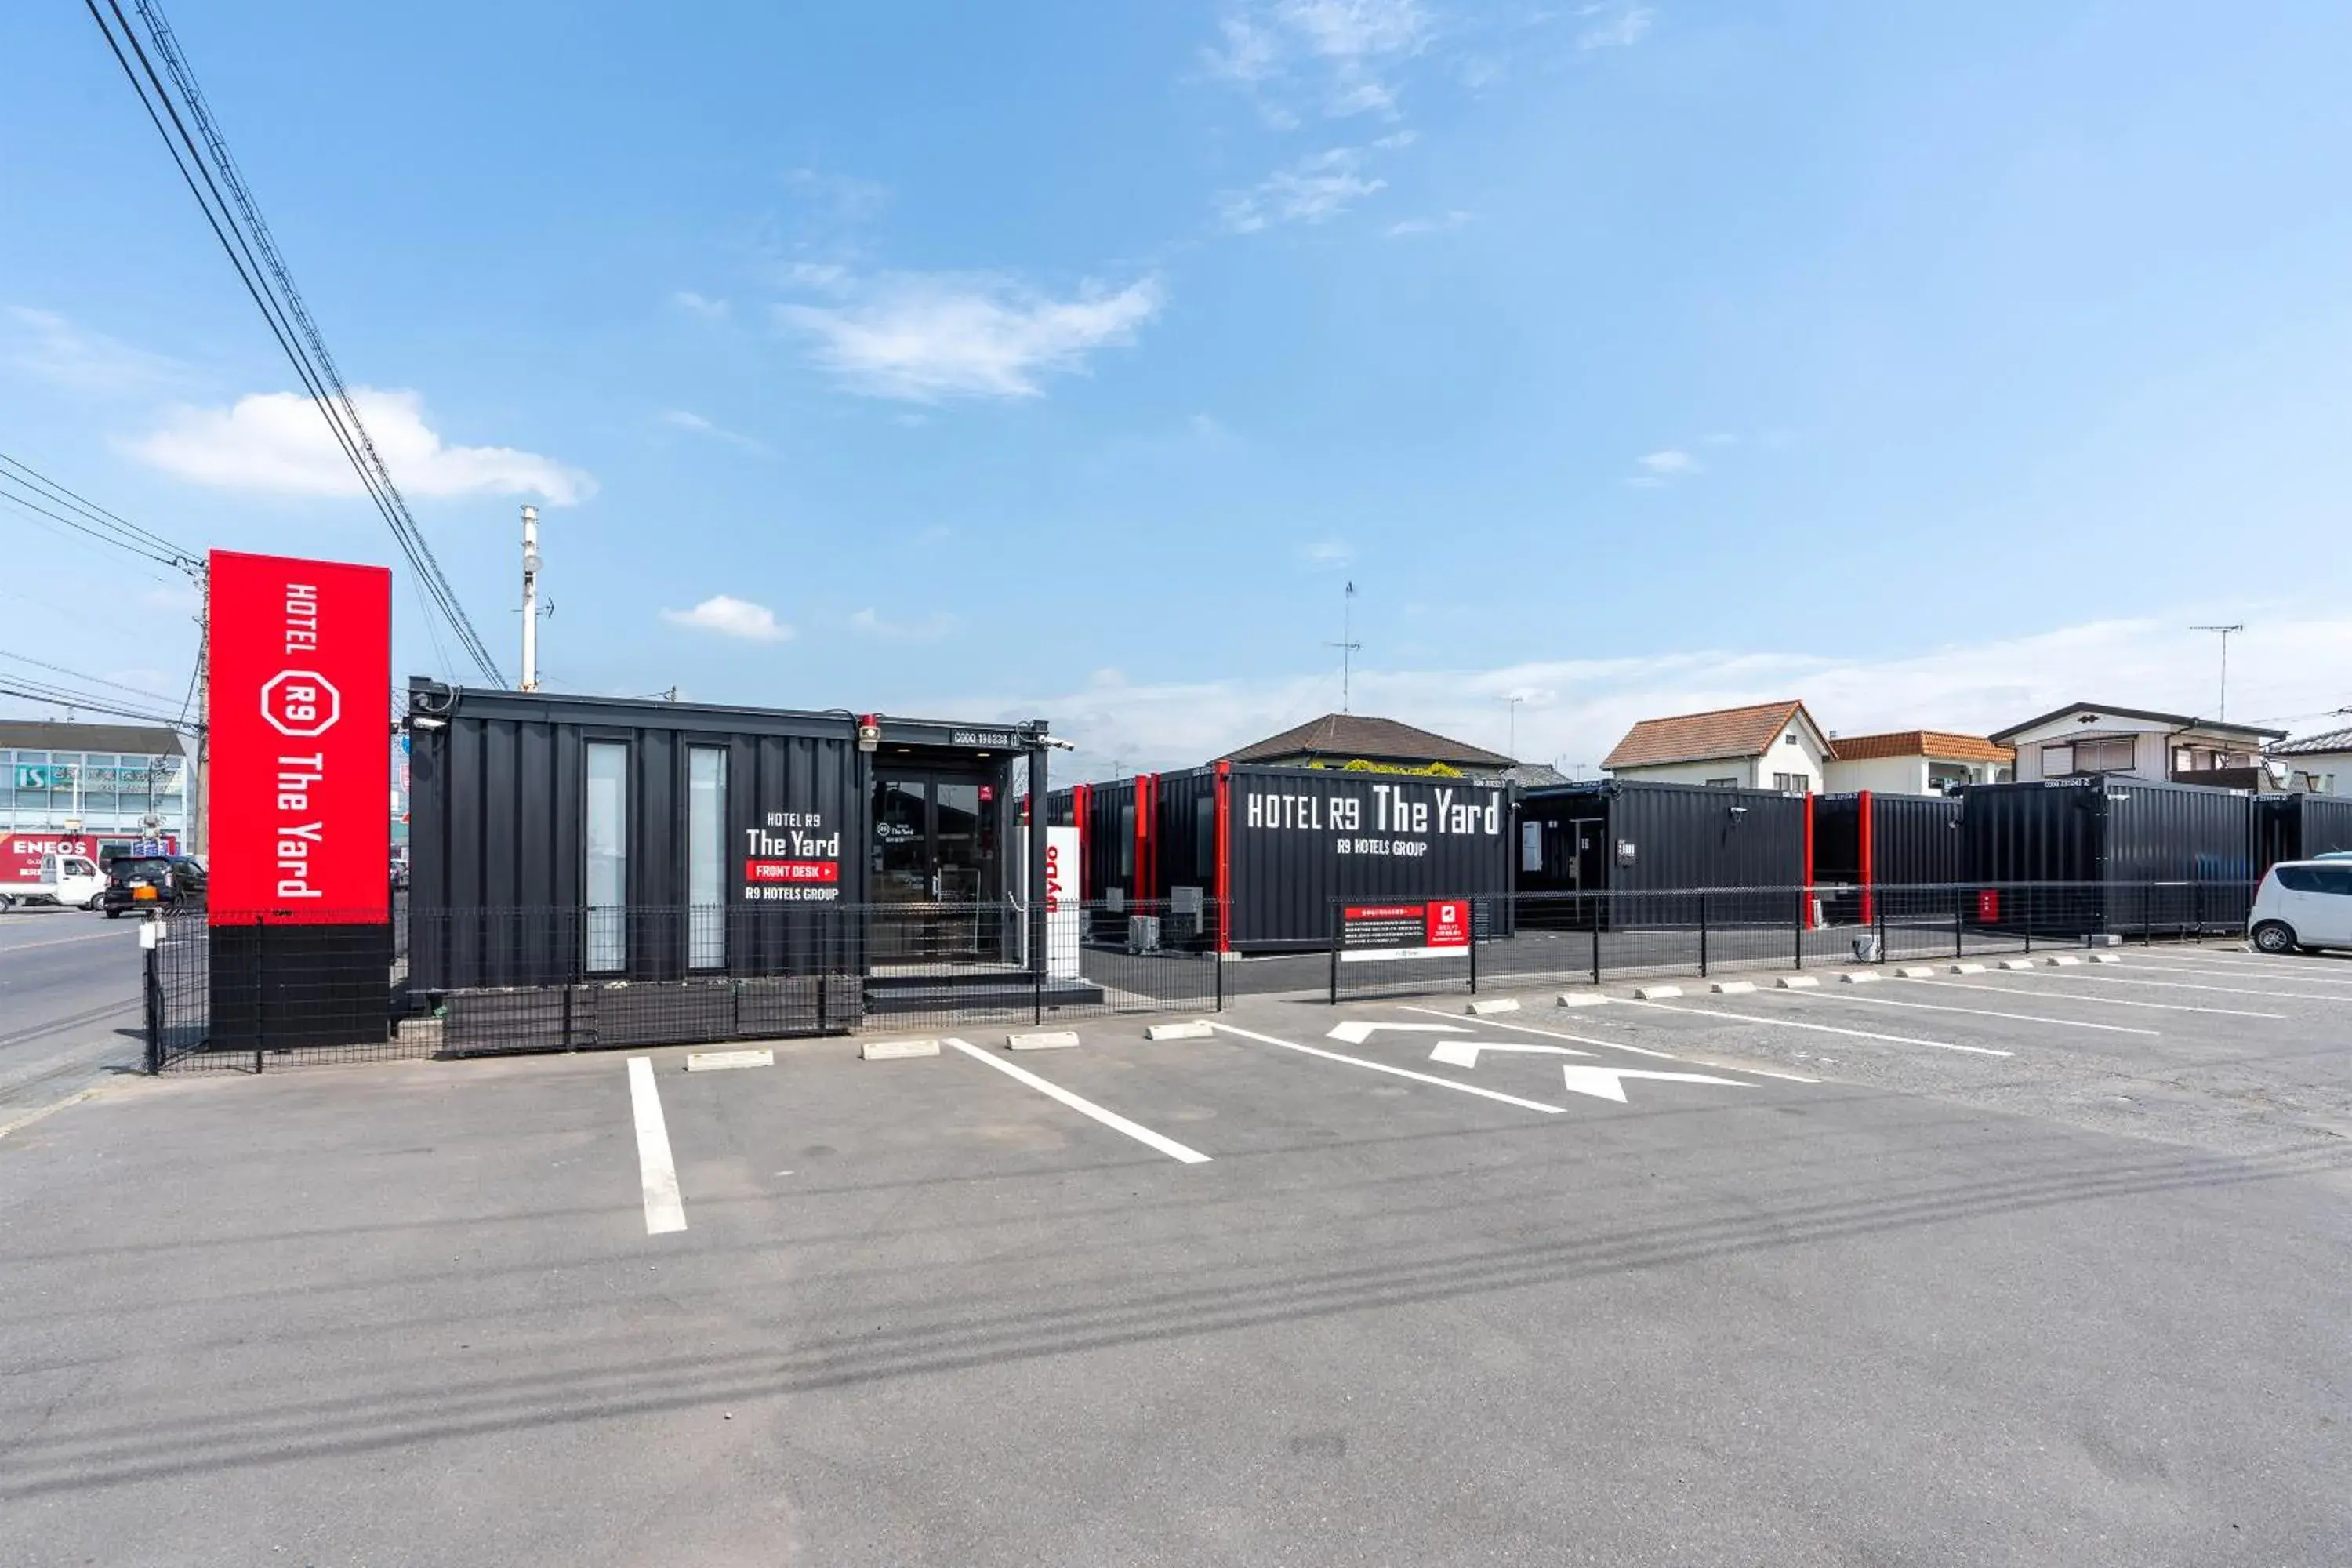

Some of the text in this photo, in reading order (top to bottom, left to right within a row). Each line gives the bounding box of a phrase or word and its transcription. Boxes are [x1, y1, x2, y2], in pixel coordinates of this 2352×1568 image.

[285, 583, 317, 655] HOTEL
[285, 686, 316, 720] R9
[278, 752, 323, 811] The
[768, 812, 821, 827] HOTEL R9
[1247, 785, 1499, 835] HOTEL R9 The Yard
[13, 840, 86, 855] ENEOS
[746, 829, 840, 857] The Yard
[1337, 838, 1428, 857] R9 HOTELS GROUP
[277, 822, 323, 898] Yard
[756, 865, 819, 877] FRONT DESK
[746, 887, 839, 901] R9 HOTELS GROUP
